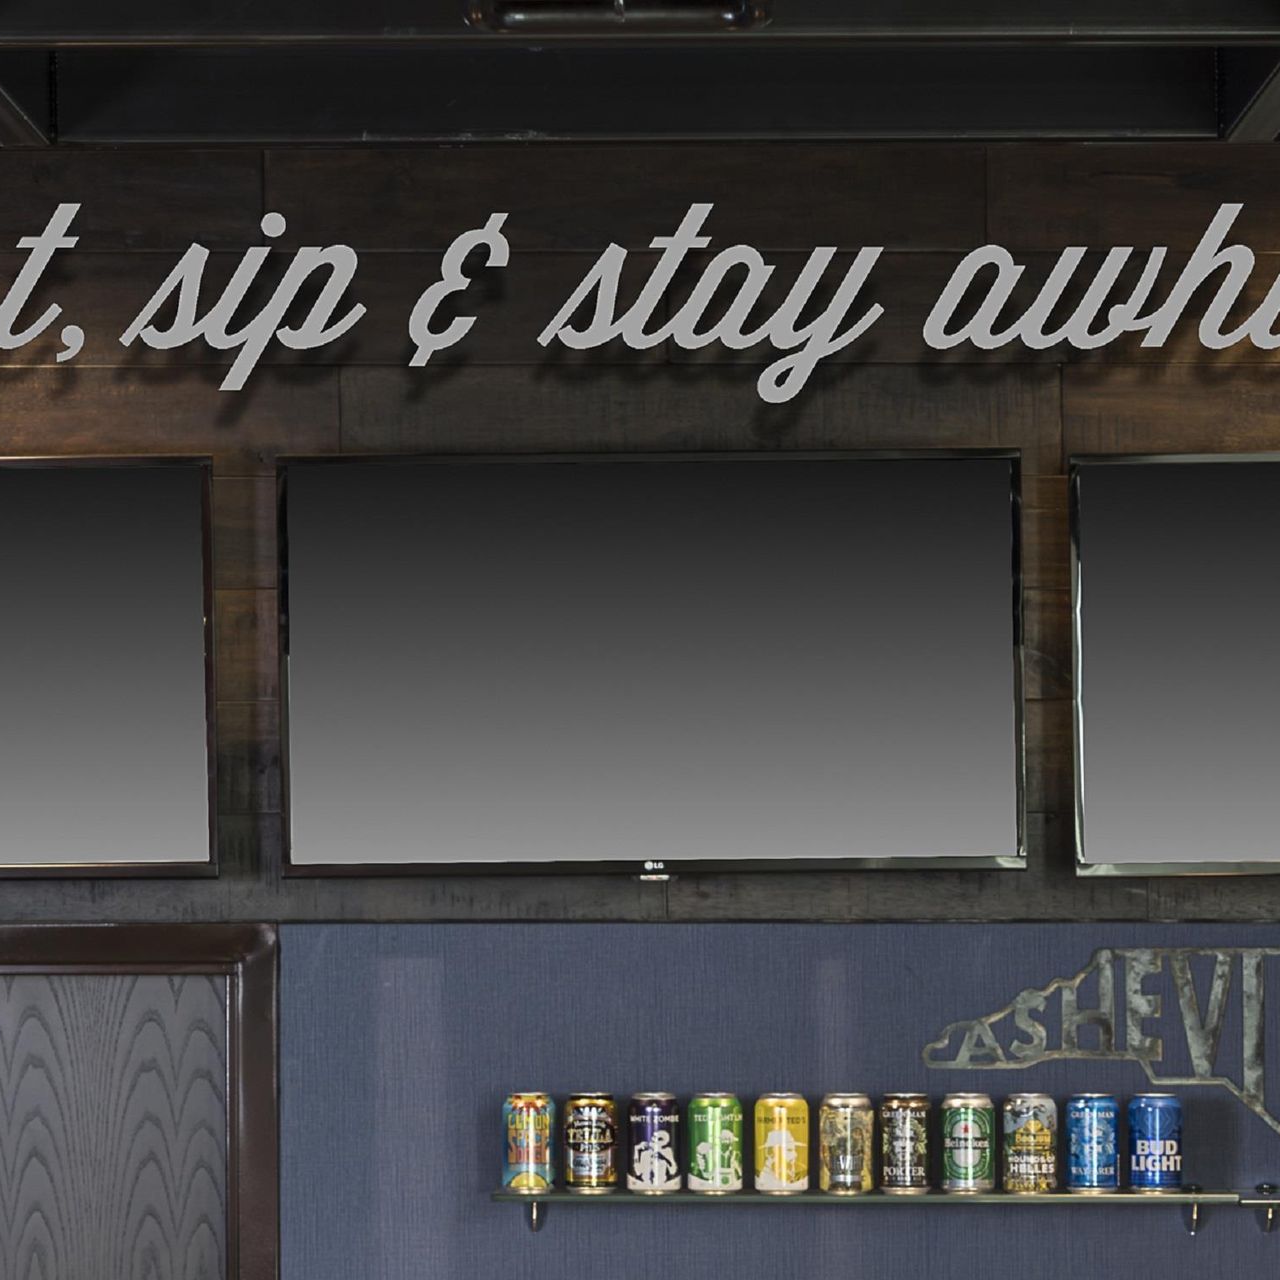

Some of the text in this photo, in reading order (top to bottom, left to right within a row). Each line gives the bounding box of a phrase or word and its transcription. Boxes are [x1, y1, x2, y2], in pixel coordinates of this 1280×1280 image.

[119, 212, 367, 391] sip
[408, 212, 510, 367] &
[537, 203, 885, 403] stay
[1136, 1140, 1178, 1155] BUD
[1010, 1163, 1055, 1174] HELLES
[1131, 1155, 1182, 1172] LIGHT
